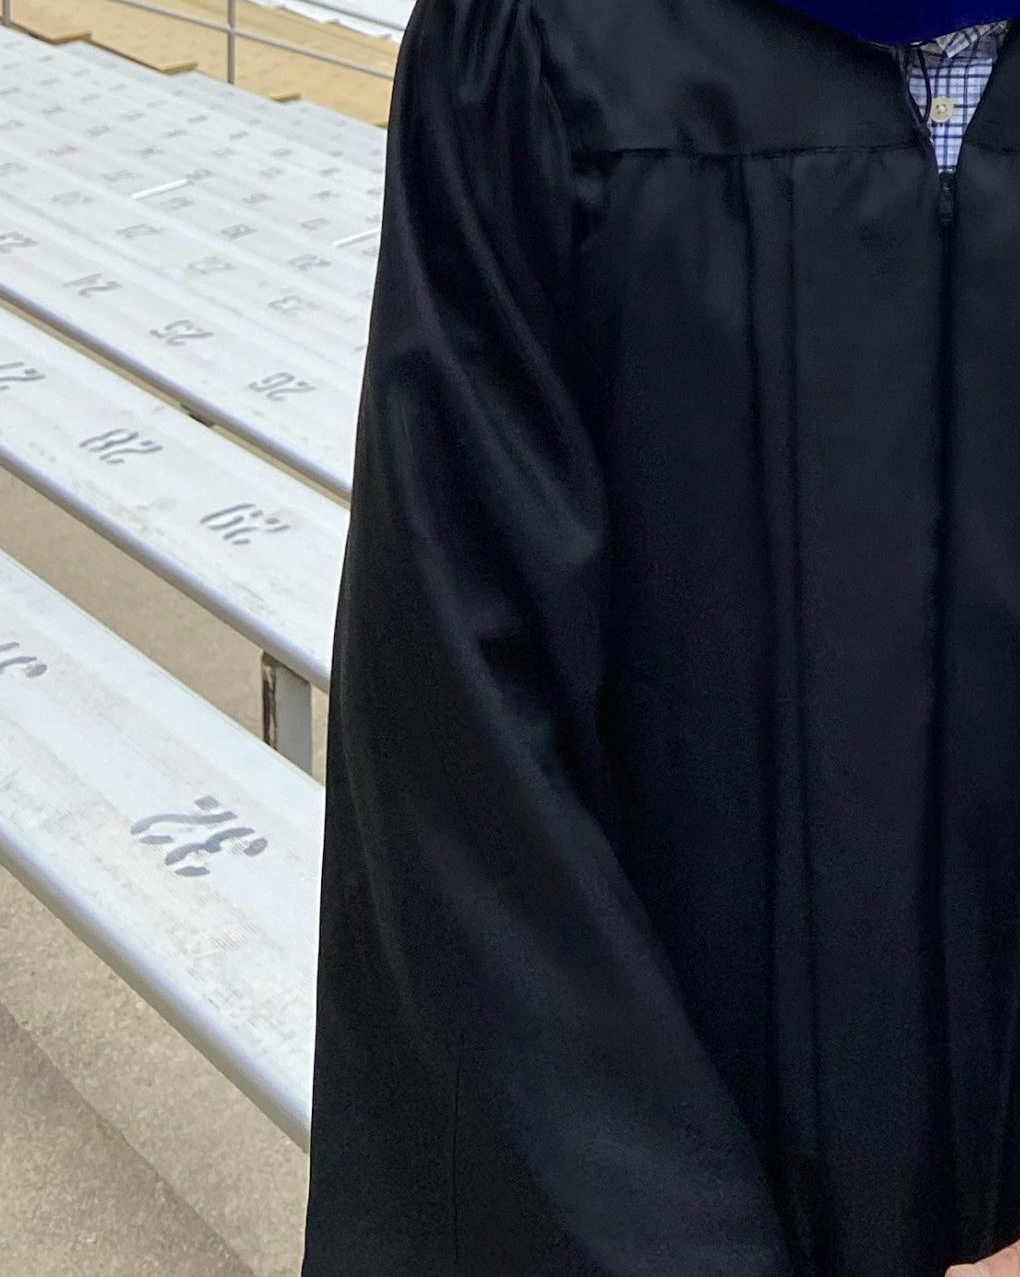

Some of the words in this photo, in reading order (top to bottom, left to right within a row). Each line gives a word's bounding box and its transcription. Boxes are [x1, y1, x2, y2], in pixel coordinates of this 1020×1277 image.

[150, 319, 213, 347] 25
[248, 372, 316, 402] 26
[79, 428, 163, 465] 28
[200, 502, 290, 546] 29
[130, 794, 269, 879] 32
